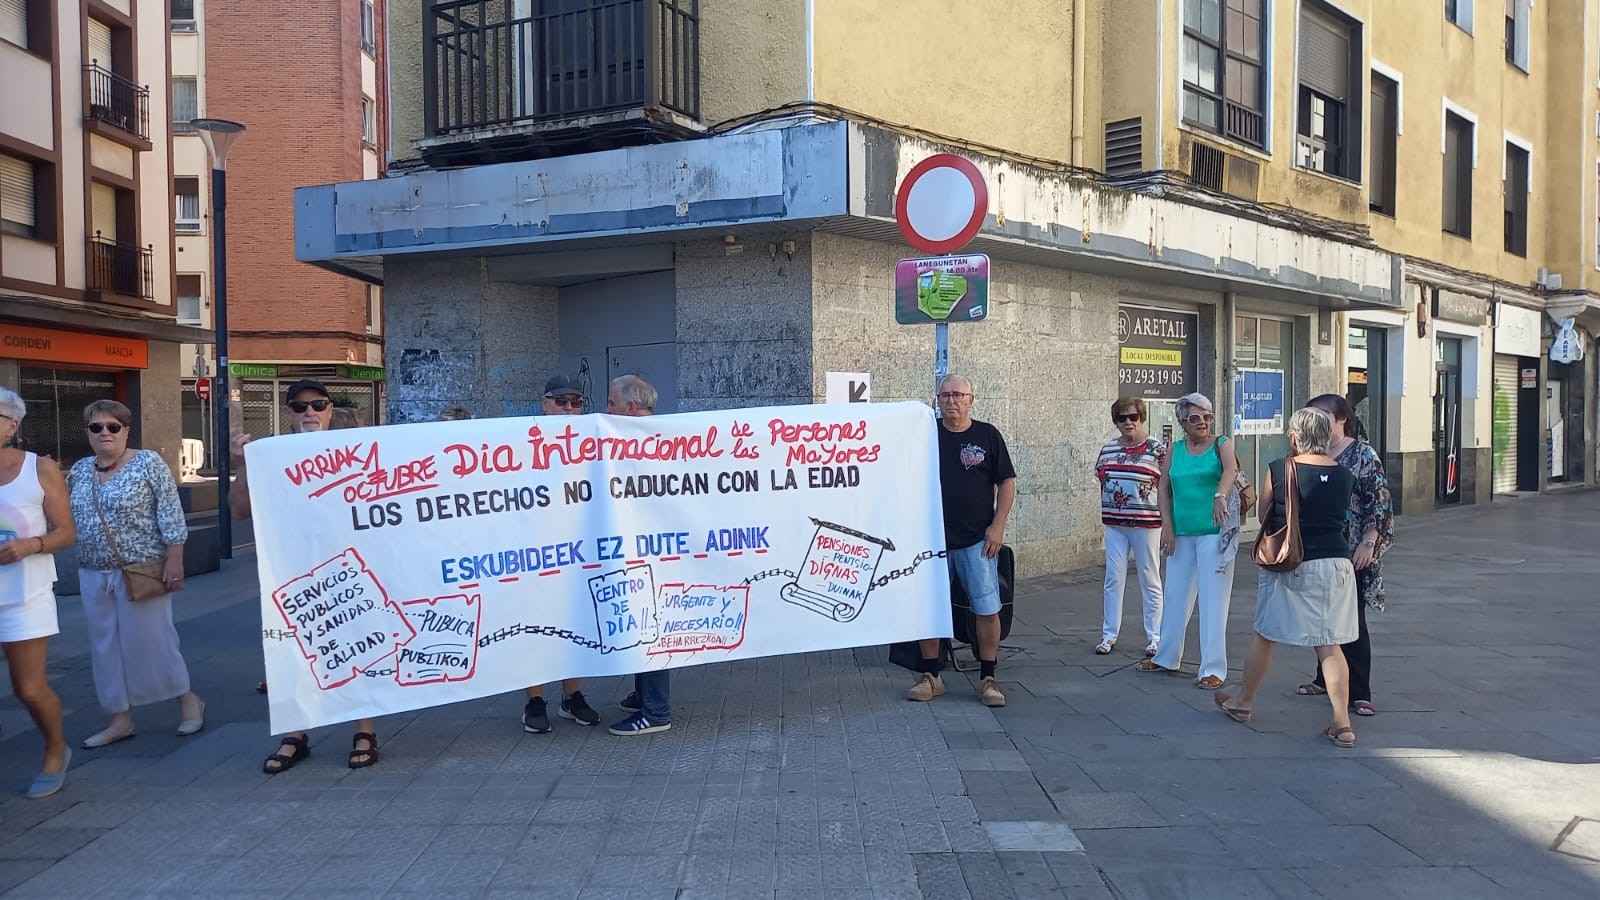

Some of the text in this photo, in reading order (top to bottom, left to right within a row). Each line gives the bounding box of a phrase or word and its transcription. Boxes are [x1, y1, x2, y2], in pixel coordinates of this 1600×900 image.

[1134, 317, 1188, 338] ARETAIL
[1126, 351, 1177, 362] LOCAL DISPONIBLE
[352, 368, 383, 380] Dental
[1119, 368, 1182, 385] 93 293 19 05
[731, 418, 867, 446] de Personas
[730, 438, 760, 460] las
[344, 455, 438, 503] OCTUBRE
[352, 465, 860, 531] LOS DERECHOS NO CADUCAN CON LA EDAD
[440, 526, 771, 584] ESKUBIDEEK EZ DUTE ADINIK
[596, 578, 645, 602] CENTRO
[611, 600, 630, 616] DE
[665, 594, 717, 611] URGENTE
[304, 630, 313, 646] Y
[318, 638, 340, 656] DE
[400, 648, 469, 670] PUBLIKOA
